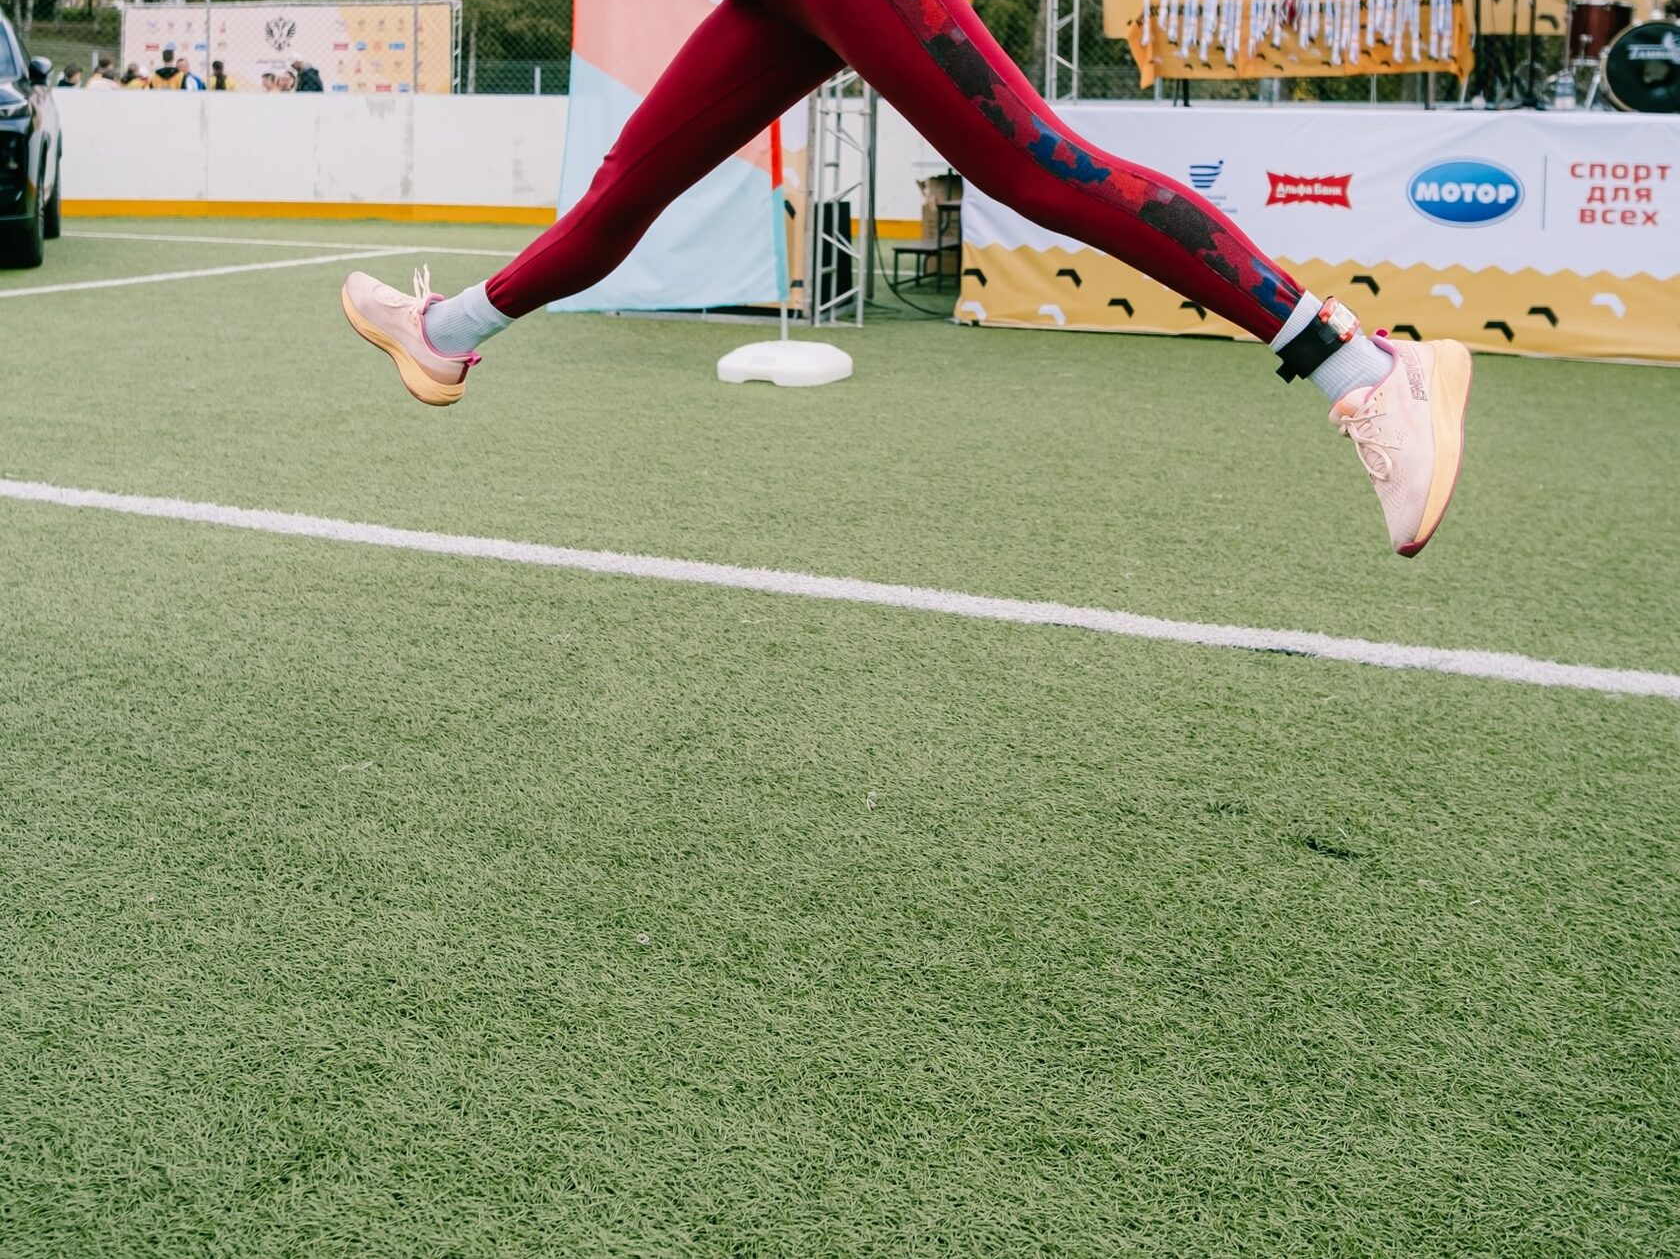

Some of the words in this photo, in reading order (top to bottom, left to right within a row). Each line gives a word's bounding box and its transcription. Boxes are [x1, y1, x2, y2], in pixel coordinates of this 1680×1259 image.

[1570, 162, 1671, 183] спорт
[1276, 182, 1312, 198] Альфа
[1314, 183, 1342, 196] Банк
[1415, 182, 1516, 204] МОТОР
[1587, 186, 1652, 204] для
[1579, 208, 1659, 227] всех
